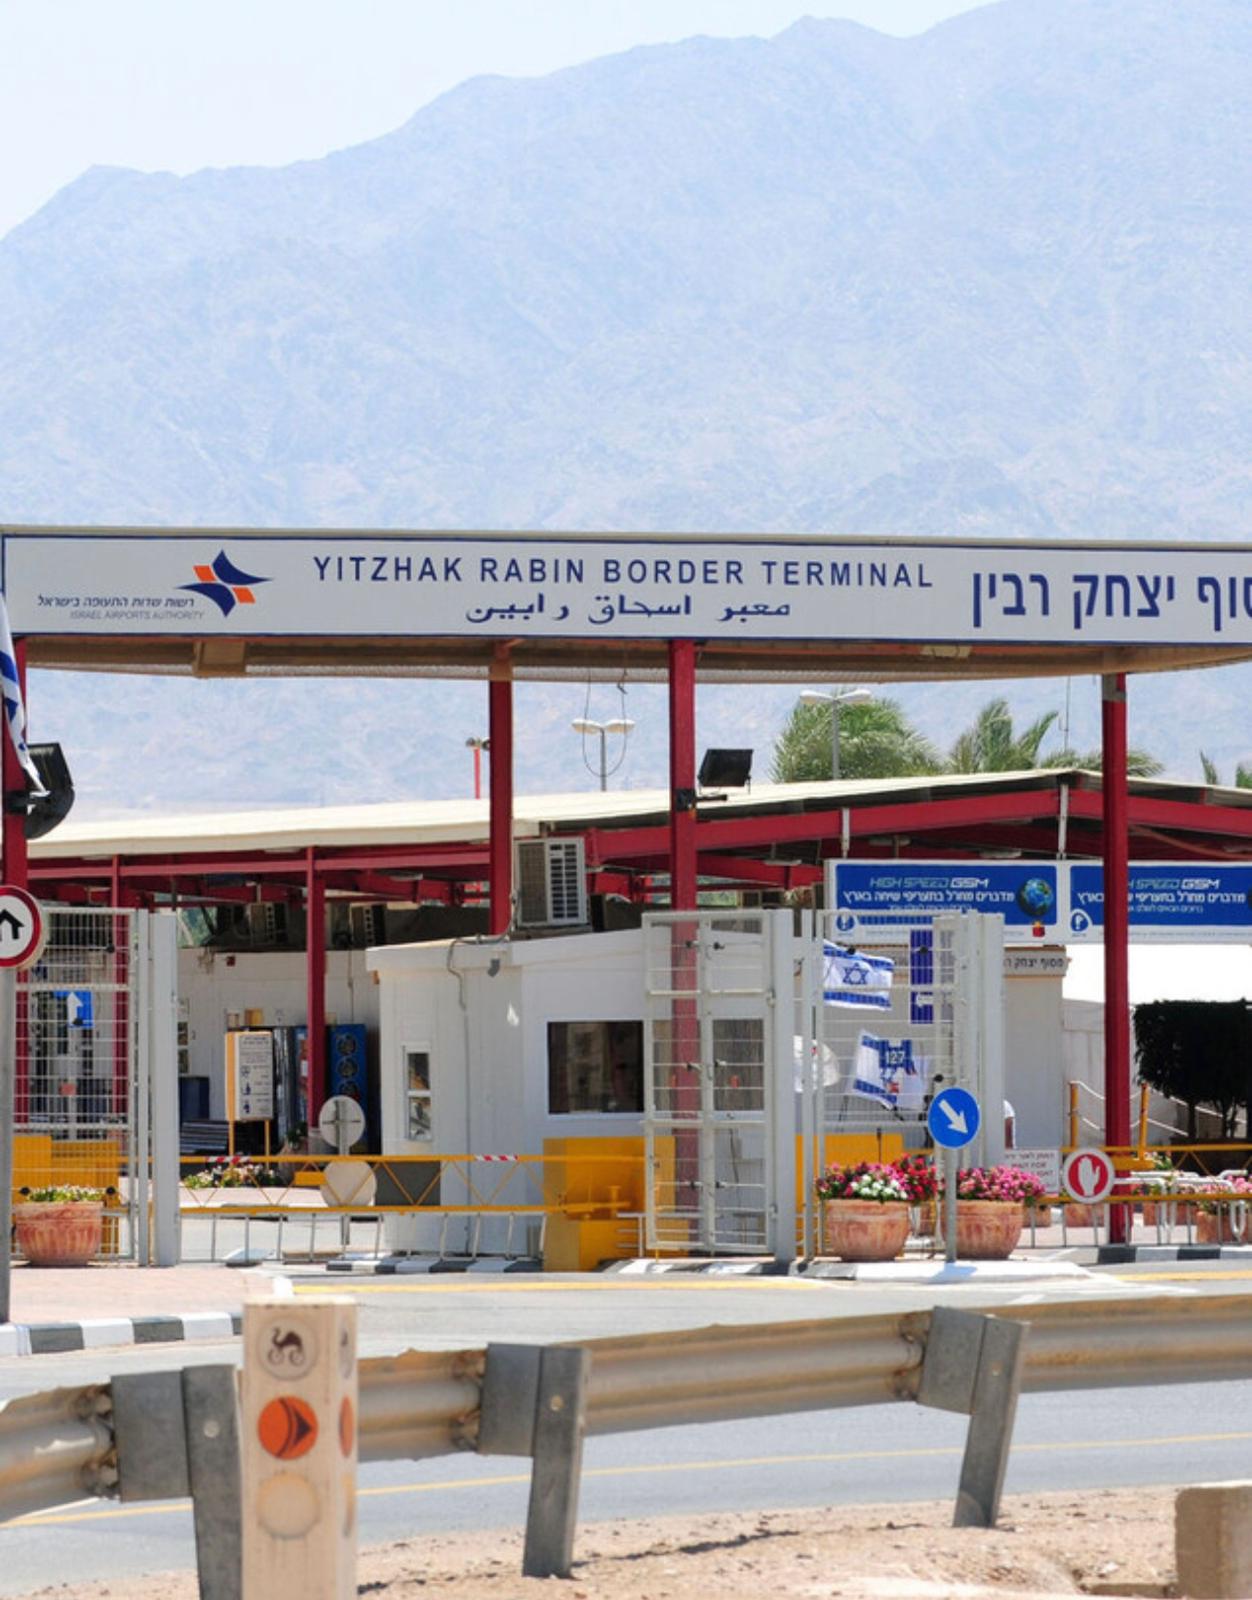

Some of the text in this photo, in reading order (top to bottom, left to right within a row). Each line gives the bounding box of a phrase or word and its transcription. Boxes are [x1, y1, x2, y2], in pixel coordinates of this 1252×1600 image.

[313, 555, 933, 588] YITZHAK RABIN BORDER TERMINAL
[37, 594, 195, 608] רשות שדות התעופה בישראל
[465, 592, 791, 625] معبر اسحاق رابين
[972, 572, 1050, 629] רבין
[1072, 573, 1175, 631] יצחק
[70, 610, 204, 620] ISRAEL AIRPORTS AUTHORITY
[870, 877, 989, 888] HIGH SPEED GSM
[1181, 878, 1220, 889] GSM
